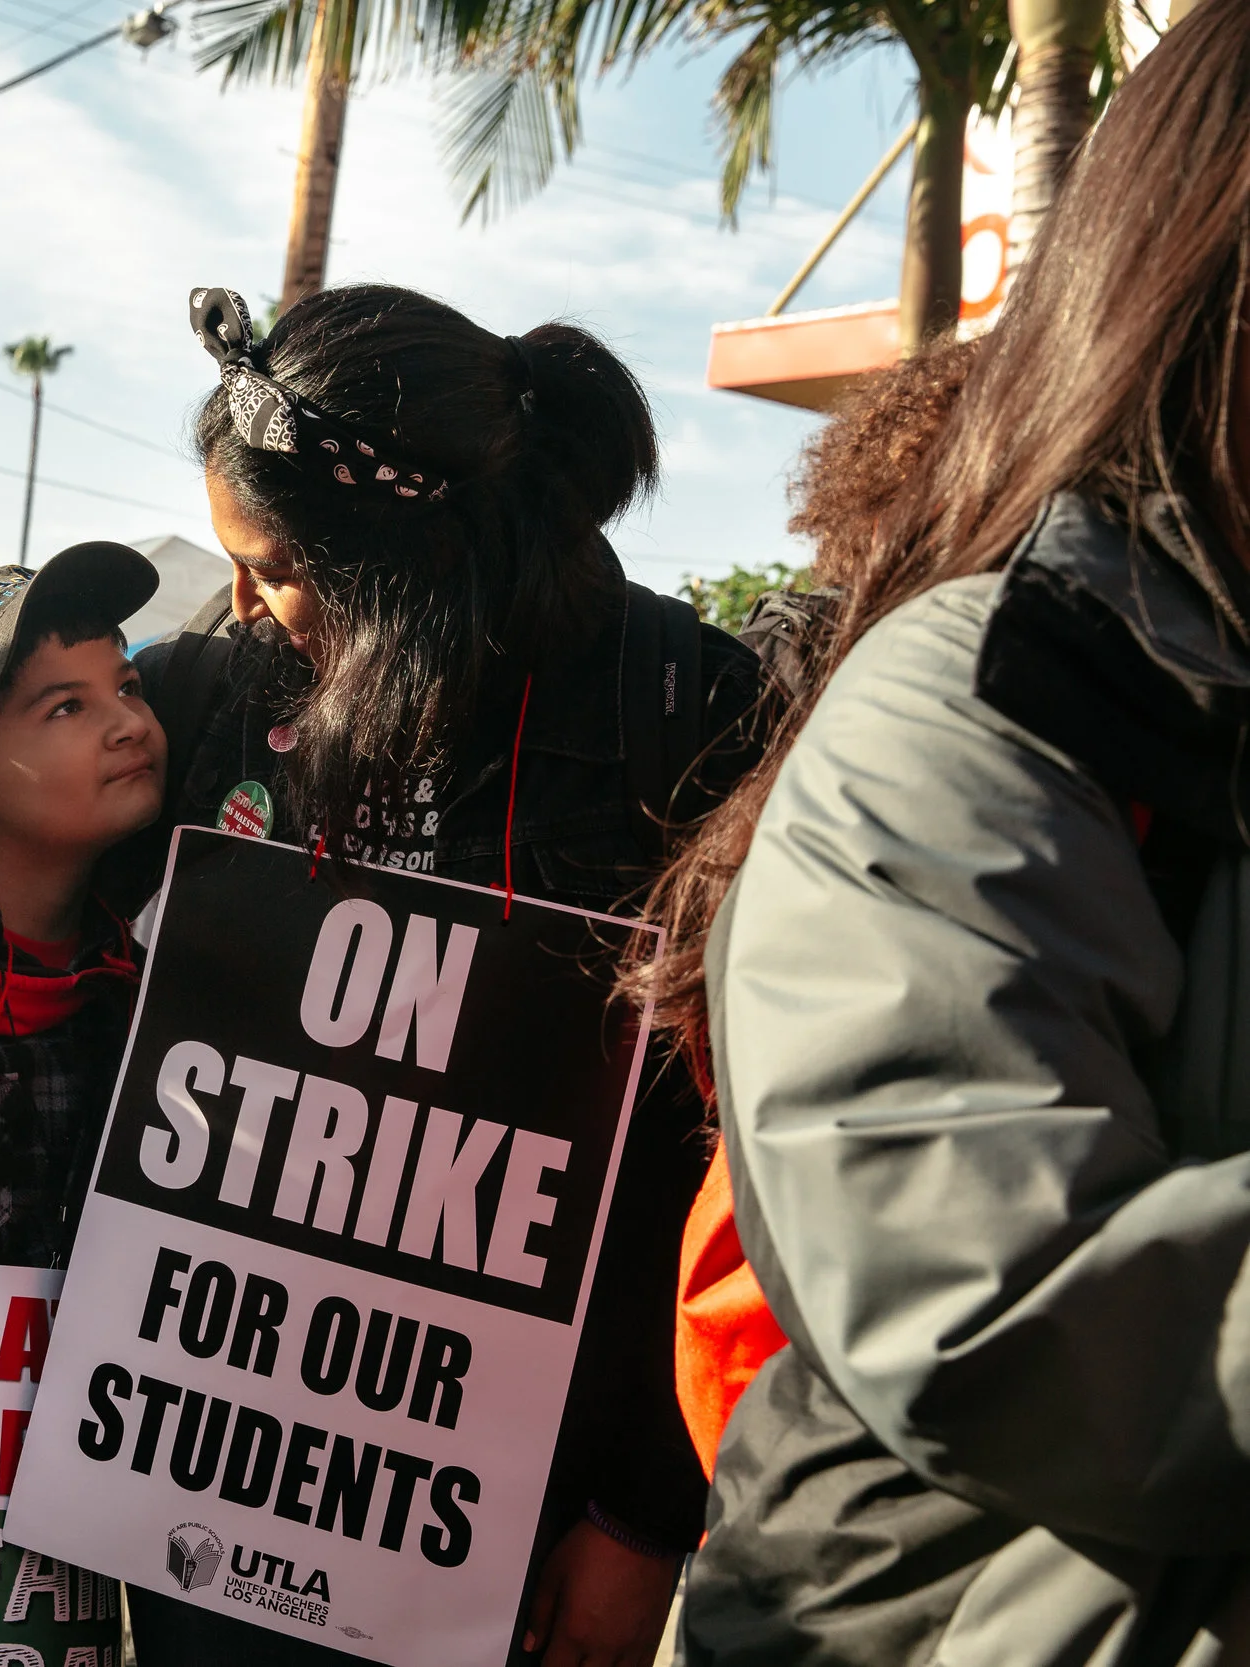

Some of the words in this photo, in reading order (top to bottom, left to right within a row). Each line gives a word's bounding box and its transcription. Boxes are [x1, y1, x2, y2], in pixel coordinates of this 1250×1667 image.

[232, 789, 254, 808] ESTOY
[414, 778, 435, 802] &
[218, 820, 232, 833] LOS
[222, 802, 235, 816] LOS
[233, 810, 267, 839] MAESTROS
[421, 810, 439, 837] &
[300, 898, 480, 1073] ON
[139, 1040, 572, 1288] STRIKE
[138, 1246, 289, 1378] FOR
[300, 1296, 472, 1430] OUR
[77, 1362, 481, 1569] STUDENTS
[167, 1528, 177, 1537] WE
[176, 1523, 187, 1531] ARE
[187, 1522, 208, 1532] PUBLIC
[208, 1529, 225, 1555] SCHOOLS
[230, 1544, 331, 1603] UTLA
[223, 1585, 253, 1604] LOS
[256, 1599, 327, 1627] ANGELES
[226, 1575, 268, 1596] UNITED
[270, 1590, 329, 1615] TEACHERS
